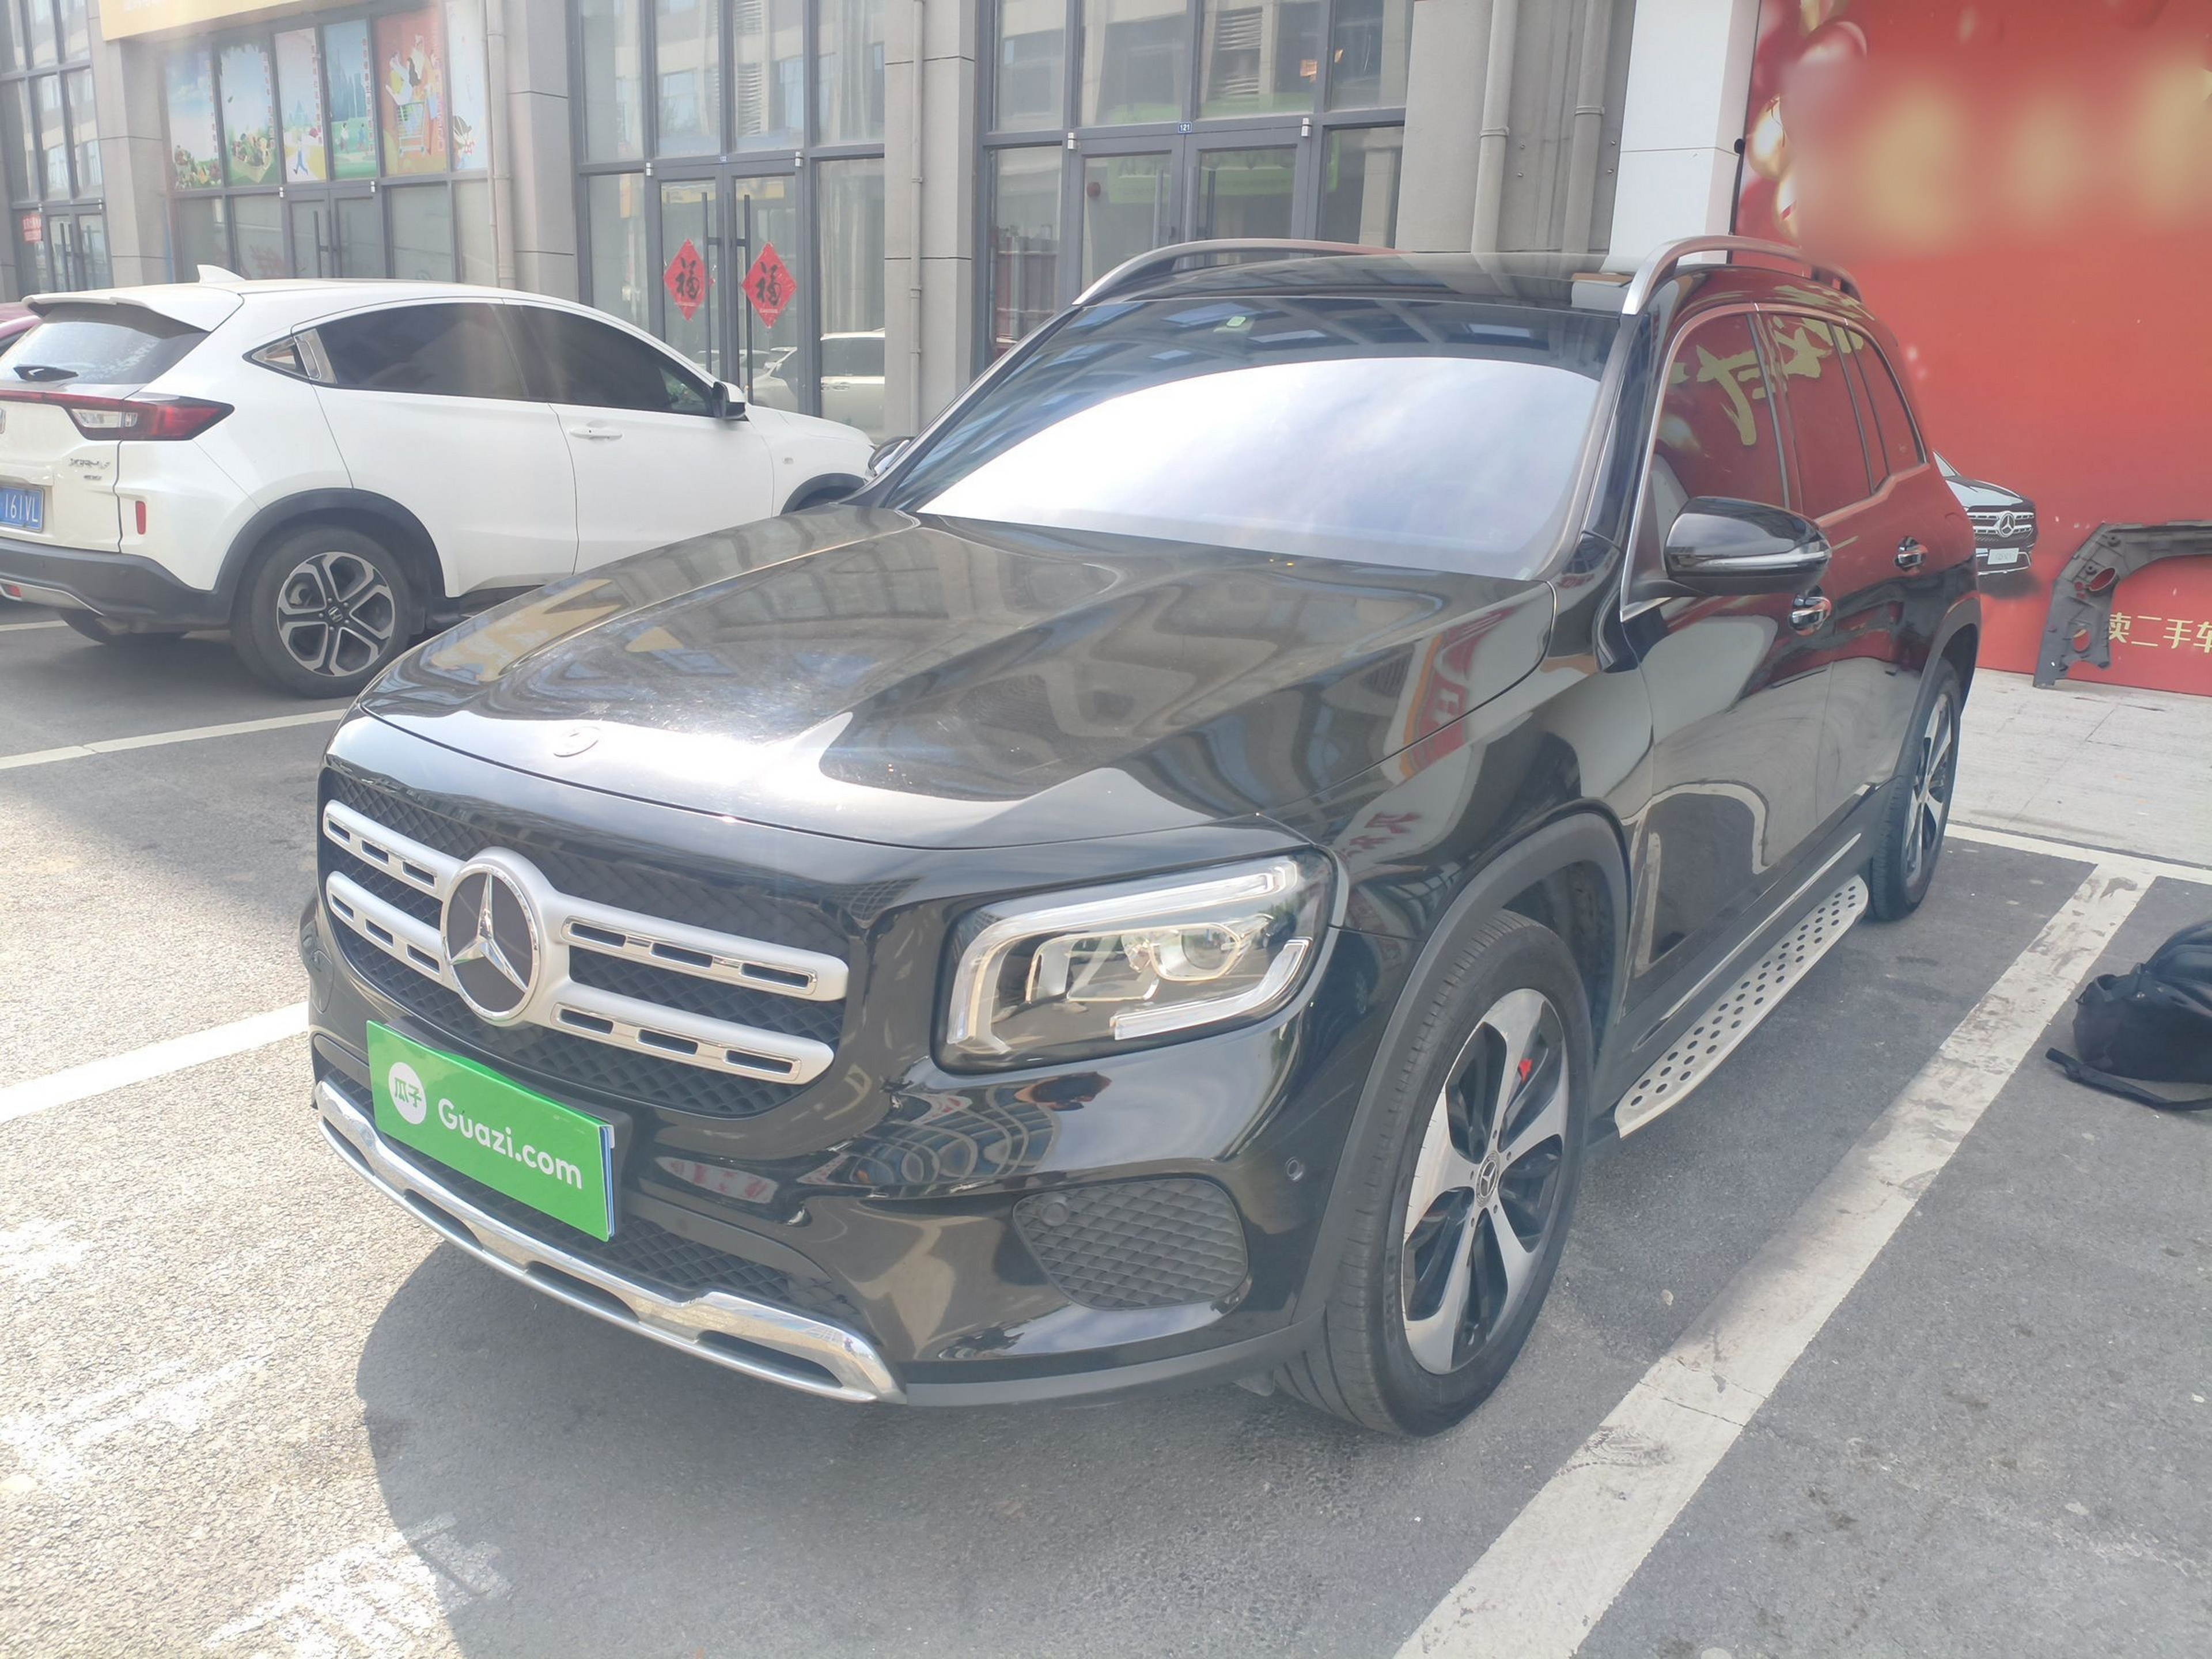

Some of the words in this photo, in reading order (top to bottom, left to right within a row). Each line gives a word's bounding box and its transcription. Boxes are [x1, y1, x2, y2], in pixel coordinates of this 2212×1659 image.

[1180, 123, 1190, 132] 121
[676, 257, 700, 300] 福
[755, 262, 781, 306] 福
[5, 493, 39, 522] 161VL
[394, 1077, 422, 1108] 瓜子
[438, 1098, 582, 1190] Guazi.com
